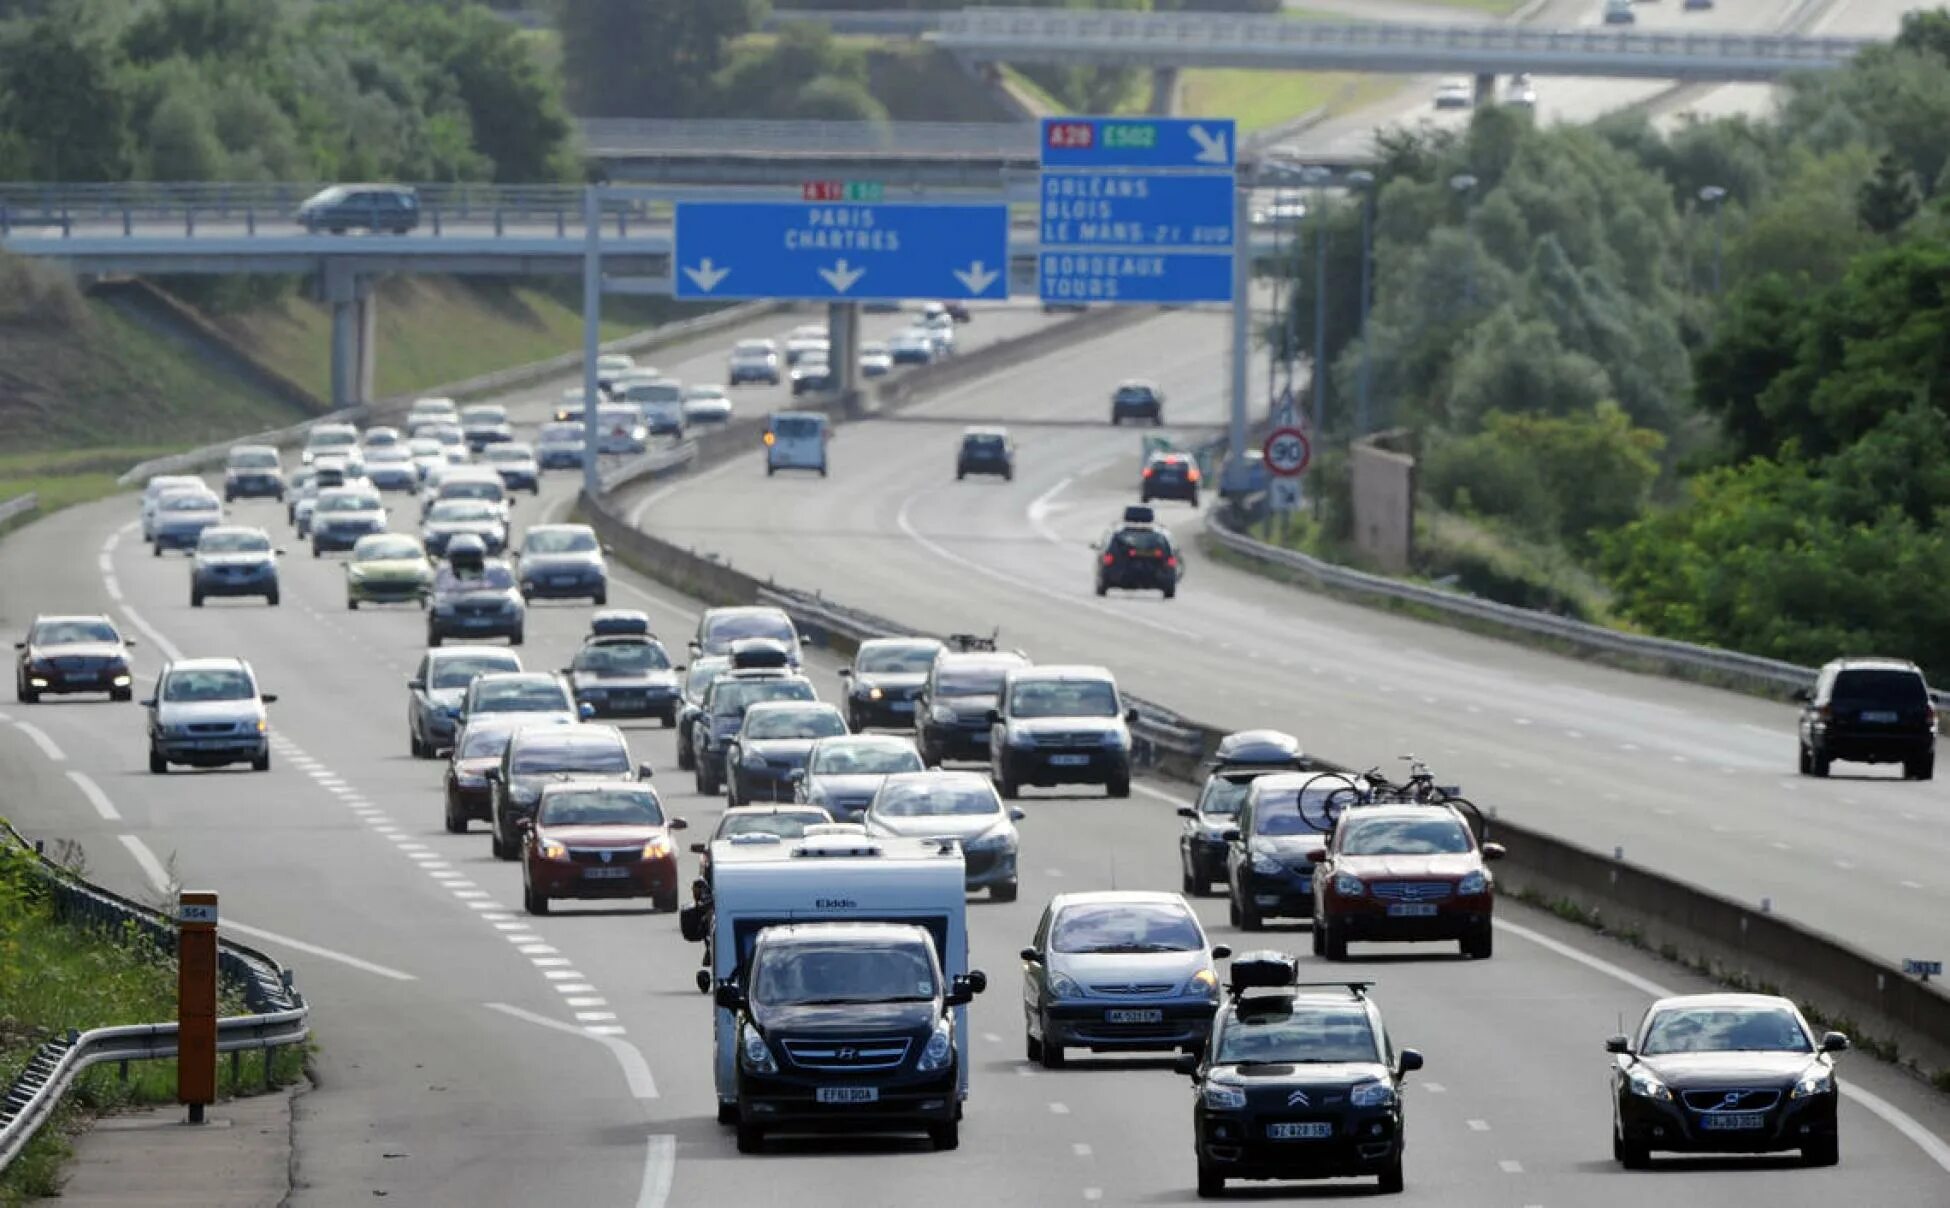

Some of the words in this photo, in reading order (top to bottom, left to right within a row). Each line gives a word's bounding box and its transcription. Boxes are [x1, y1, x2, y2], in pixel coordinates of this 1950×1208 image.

[809, 208, 874, 226] PARIS
[1046, 200, 1112, 219] BLOIS
[785, 230, 899, 251] CHARTRES
[1044, 223, 1069, 242] LE
[1080, 222, 1143, 242] MANS
[1044, 256, 1165, 276] BORDEAUX
[1045, 278, 1118, 297] TOURS
[1272, 441, 1301, 461] 90
